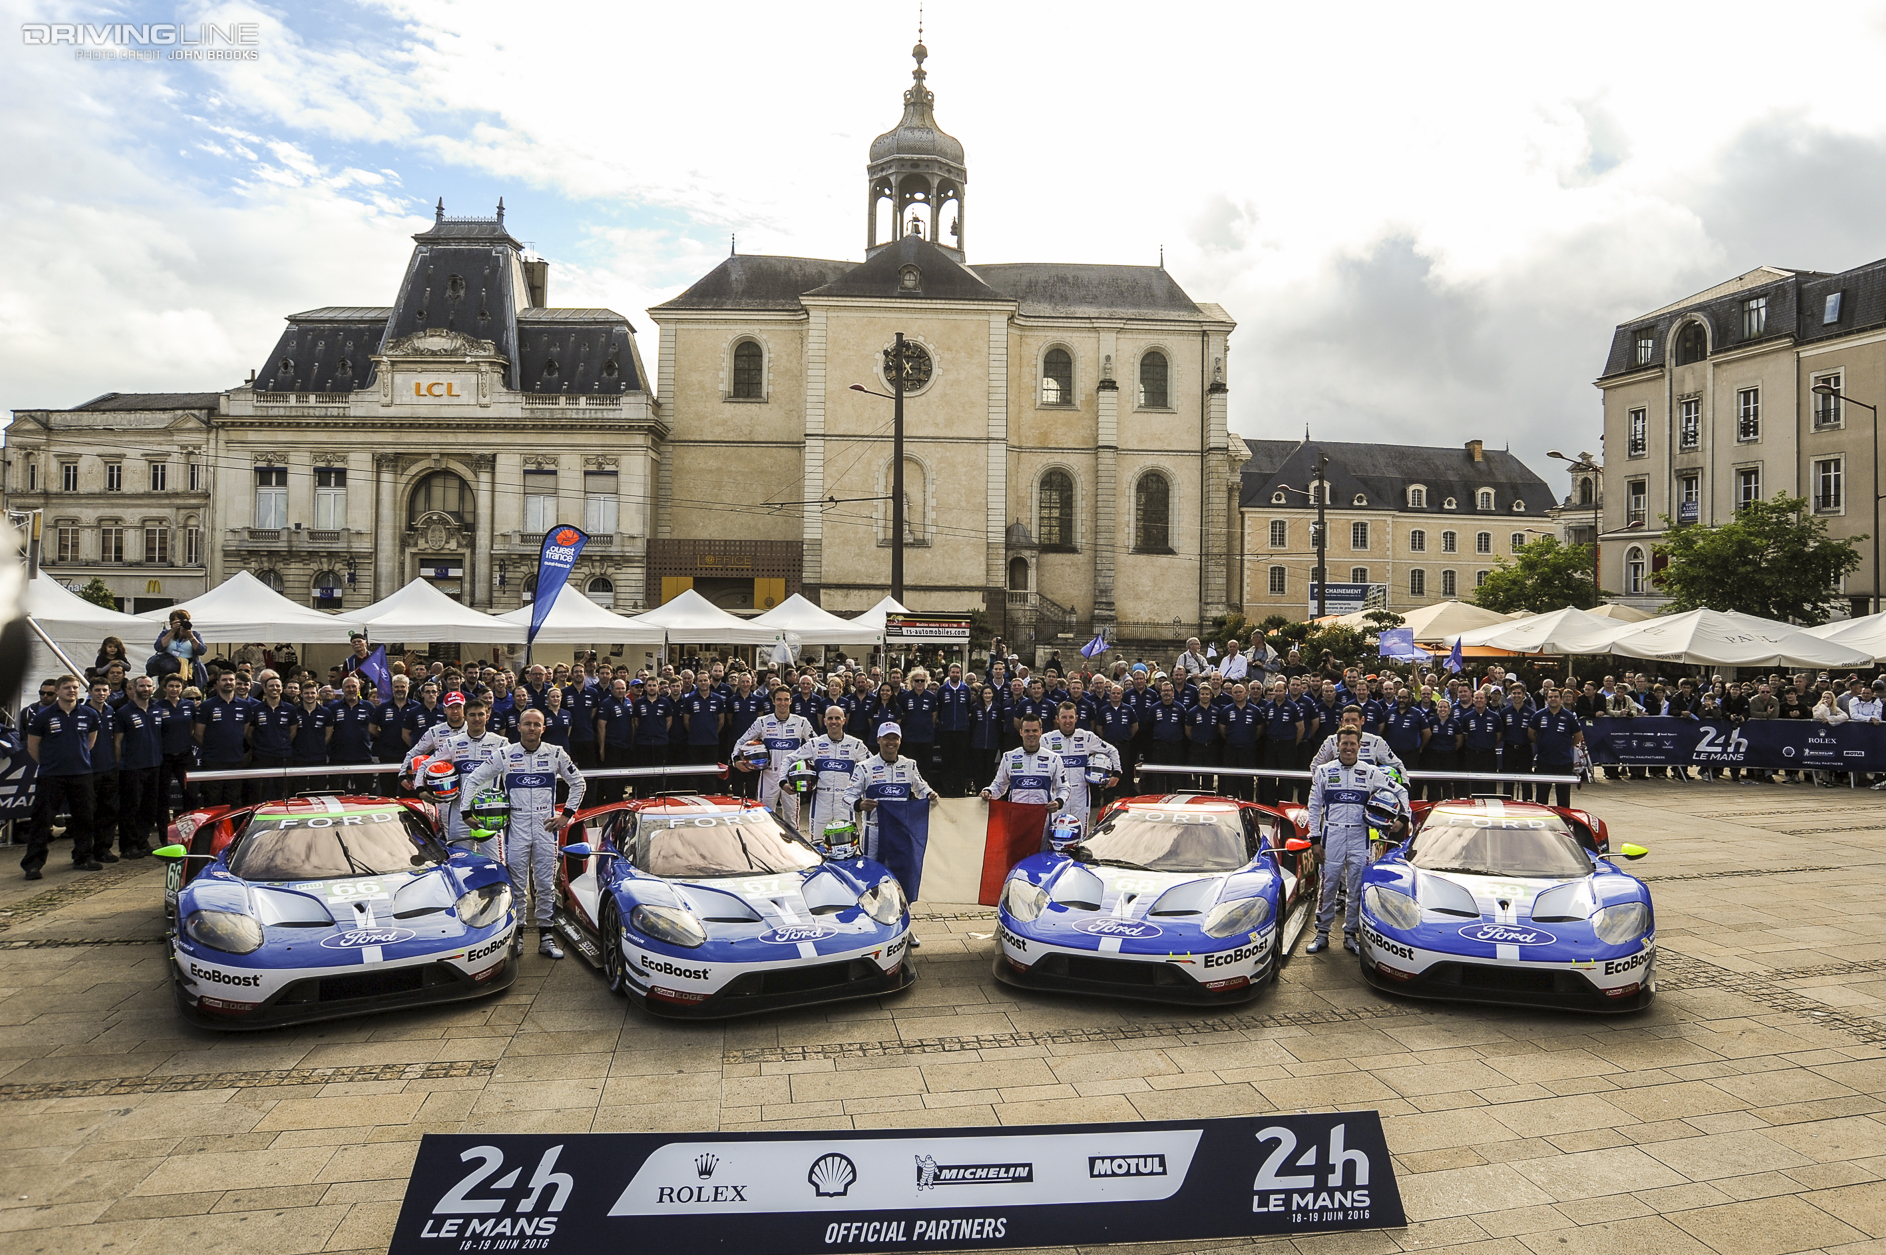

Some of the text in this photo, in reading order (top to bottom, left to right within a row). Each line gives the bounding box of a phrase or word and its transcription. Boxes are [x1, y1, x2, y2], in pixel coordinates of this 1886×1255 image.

[415, 382, 461, 397] LCL
[546, 549, 573, 563] france
[550, 545, 575, 556] ouest
[1695, 726, 1749, 752] 24h
[1709, 753, 1744, 761] MANS
[522, 776, 541, 785] Ford
[1021, 778, 1038, 786] Ford
[884, 786, 901, 794] Ford
[278, 813, 392, 830] FORD
[669, 813, 766, 829] FORD
[1124, 811, 1219, 824] FORD
[1448, 818, 1547, 829] FORD
[167, 862, 182, 893] 66
[1115, 878, 1157, 892] 68
[298, 882, 322, 890] PRO
[331, 881, 380, 896] 66
[743, 879, 780, 893] 67
[775, 925, 824, 942] Ford
[1088, 919, 1146, 937] Ford
[1476, 924, 1538, 943] Ford
[340, 929, 398, 947] Ford
[1204, 938, 1268, 969] EcoBoost
[190, 962, 260, 987] EcoBoost
[641, 954, 709, 980] EcoBoost
[675, 992, 704, 1001] EDGE
[223, 1002, 253, 1011] EDGE
[1254, 1123, 1370, 1191] 24h
[939, 1165, 1030, 1180] MICHELIN
[1093, 1156, 1164, 1175] MOTUL
[431, 1144, 574, 1214] 24h
[656, 1184, 748, 1204] ROLEX
[1252, 1189, 1371, 1213] LE MANS
[1291, 1209, 1370, 1223] 18-19 JUIN 2016
[420, 1216, 559, 1238] LE MANS
[824, 1217, 1007, 1244] OFFICIAL PARTNERS
[458, 1238, 550, 1251] 18-19 JUIN 2016
